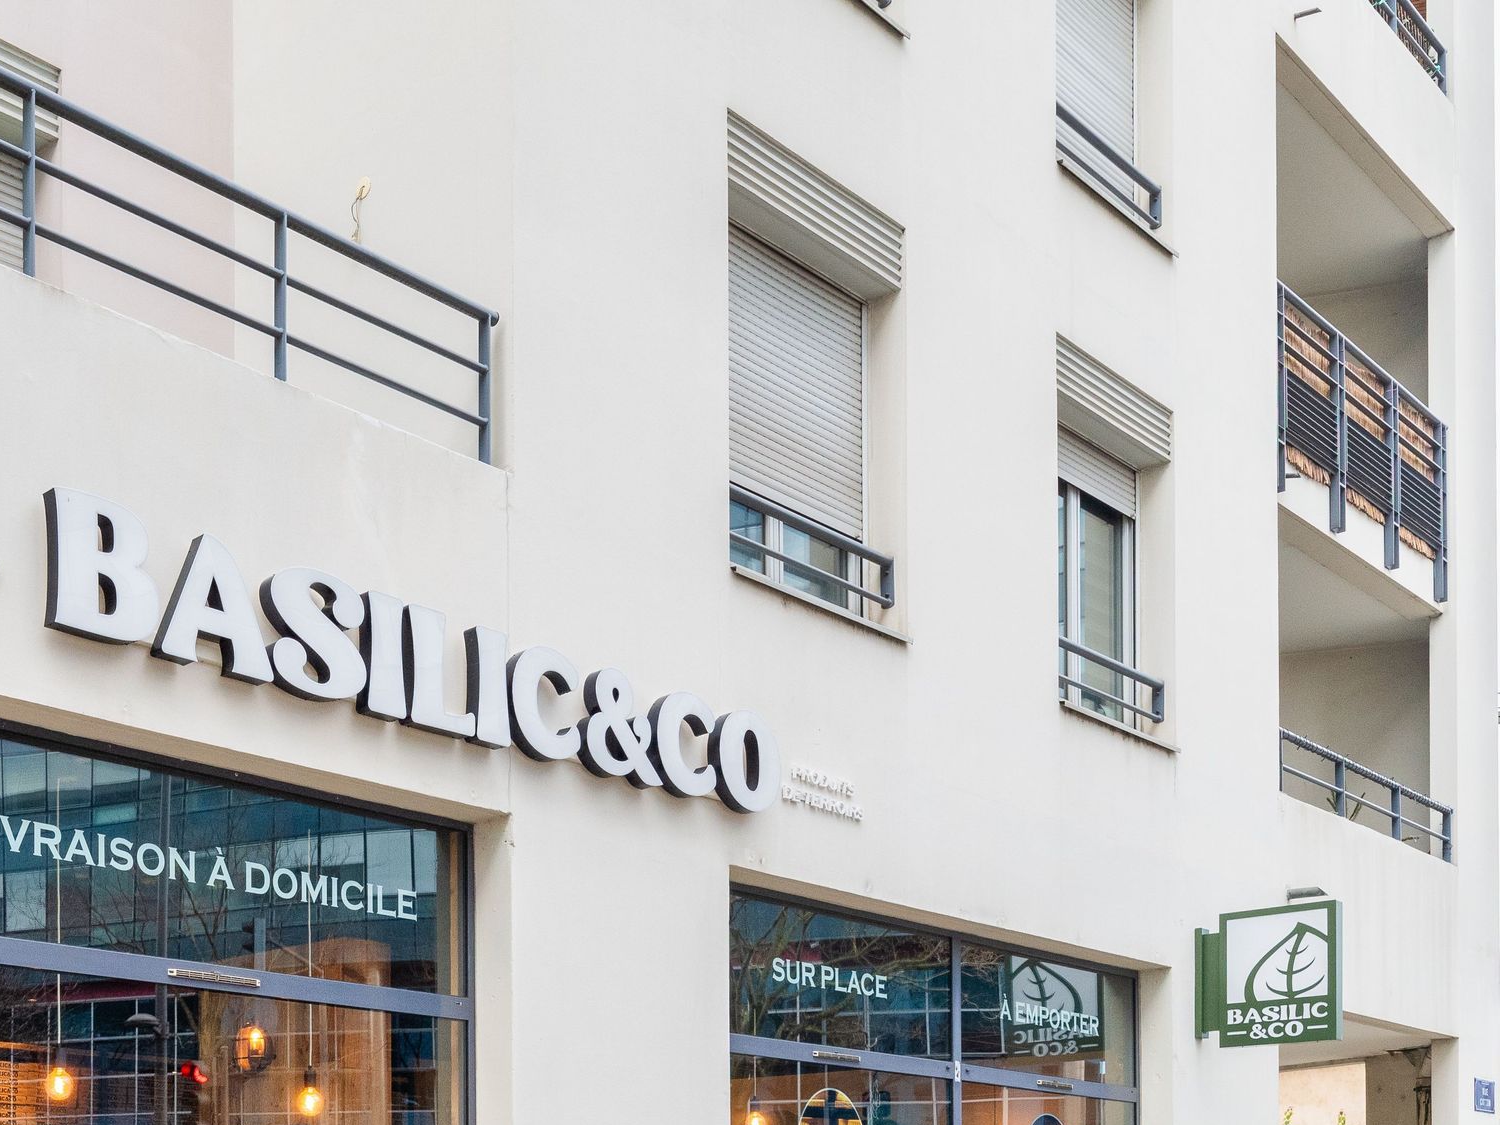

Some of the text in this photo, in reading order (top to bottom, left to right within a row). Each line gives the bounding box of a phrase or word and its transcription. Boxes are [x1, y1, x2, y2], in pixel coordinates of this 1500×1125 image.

[43, 486, 781, 814] BASILIC&CO
[206, 847, 235, 890] À
[244, 861, 418, 921] DOMICILE
[772, 957, 888, 999] SUR PLACE
[1000, 993, 1100, 1036] À EMPORTER
[1227, 1002, 1329, 1025] BASILIC
[1249, 1020, 1304, 1039] &CO
